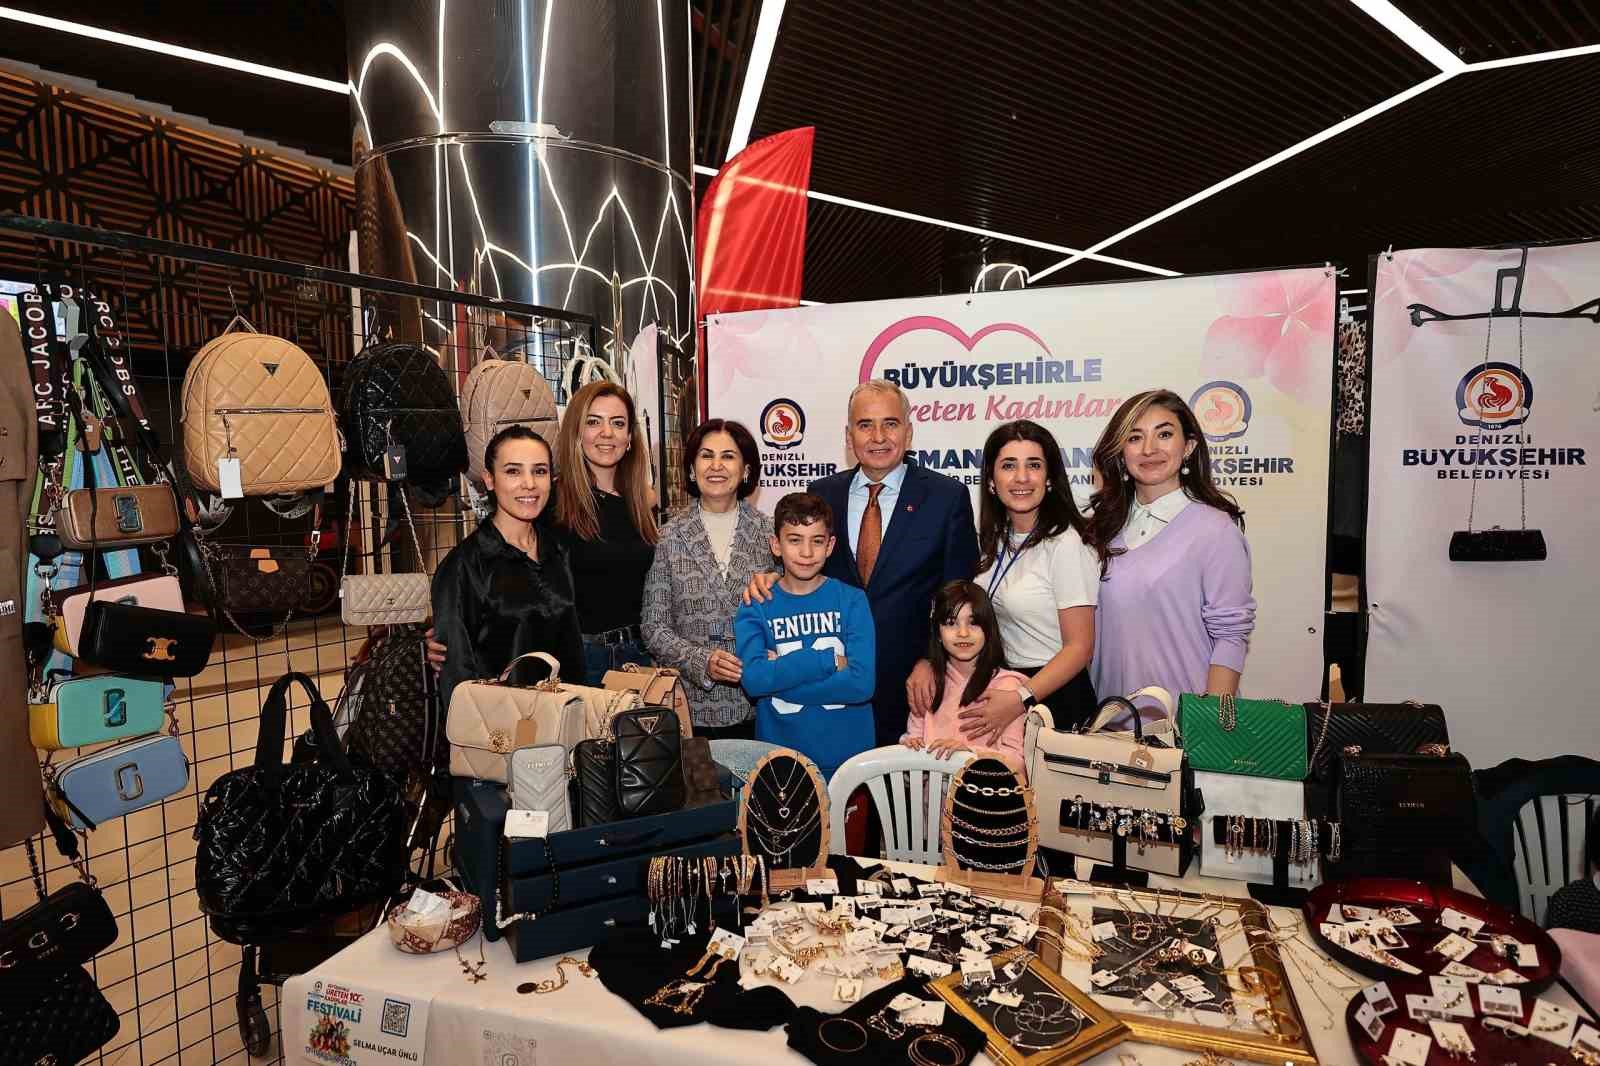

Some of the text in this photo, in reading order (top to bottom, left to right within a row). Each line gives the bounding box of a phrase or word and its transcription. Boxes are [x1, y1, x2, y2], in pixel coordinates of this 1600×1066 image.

[884, 356, 1103, 390] BÜYÜKŞEHİRLE
[35, 382, 56, 425] ARC
[908, 393, 1122, 423] reten Kadınlar
[903, 448, 983, 469] SMAN
[1209, 445, 1249, 455] NİZLİ
[1402, 447, 1587, 467] BÜYÜKŞEHİR
[760, 463, 837, 477] ÜKŞEHİR
[1211, 457, 1294, 474] KŞEHİR
[1437, 469, 1550, 480] BELEDİYESİ
[1213, 476, 1264, 486] DİYESİ
[306, 999, 362, 1024] FESTİVALİ
